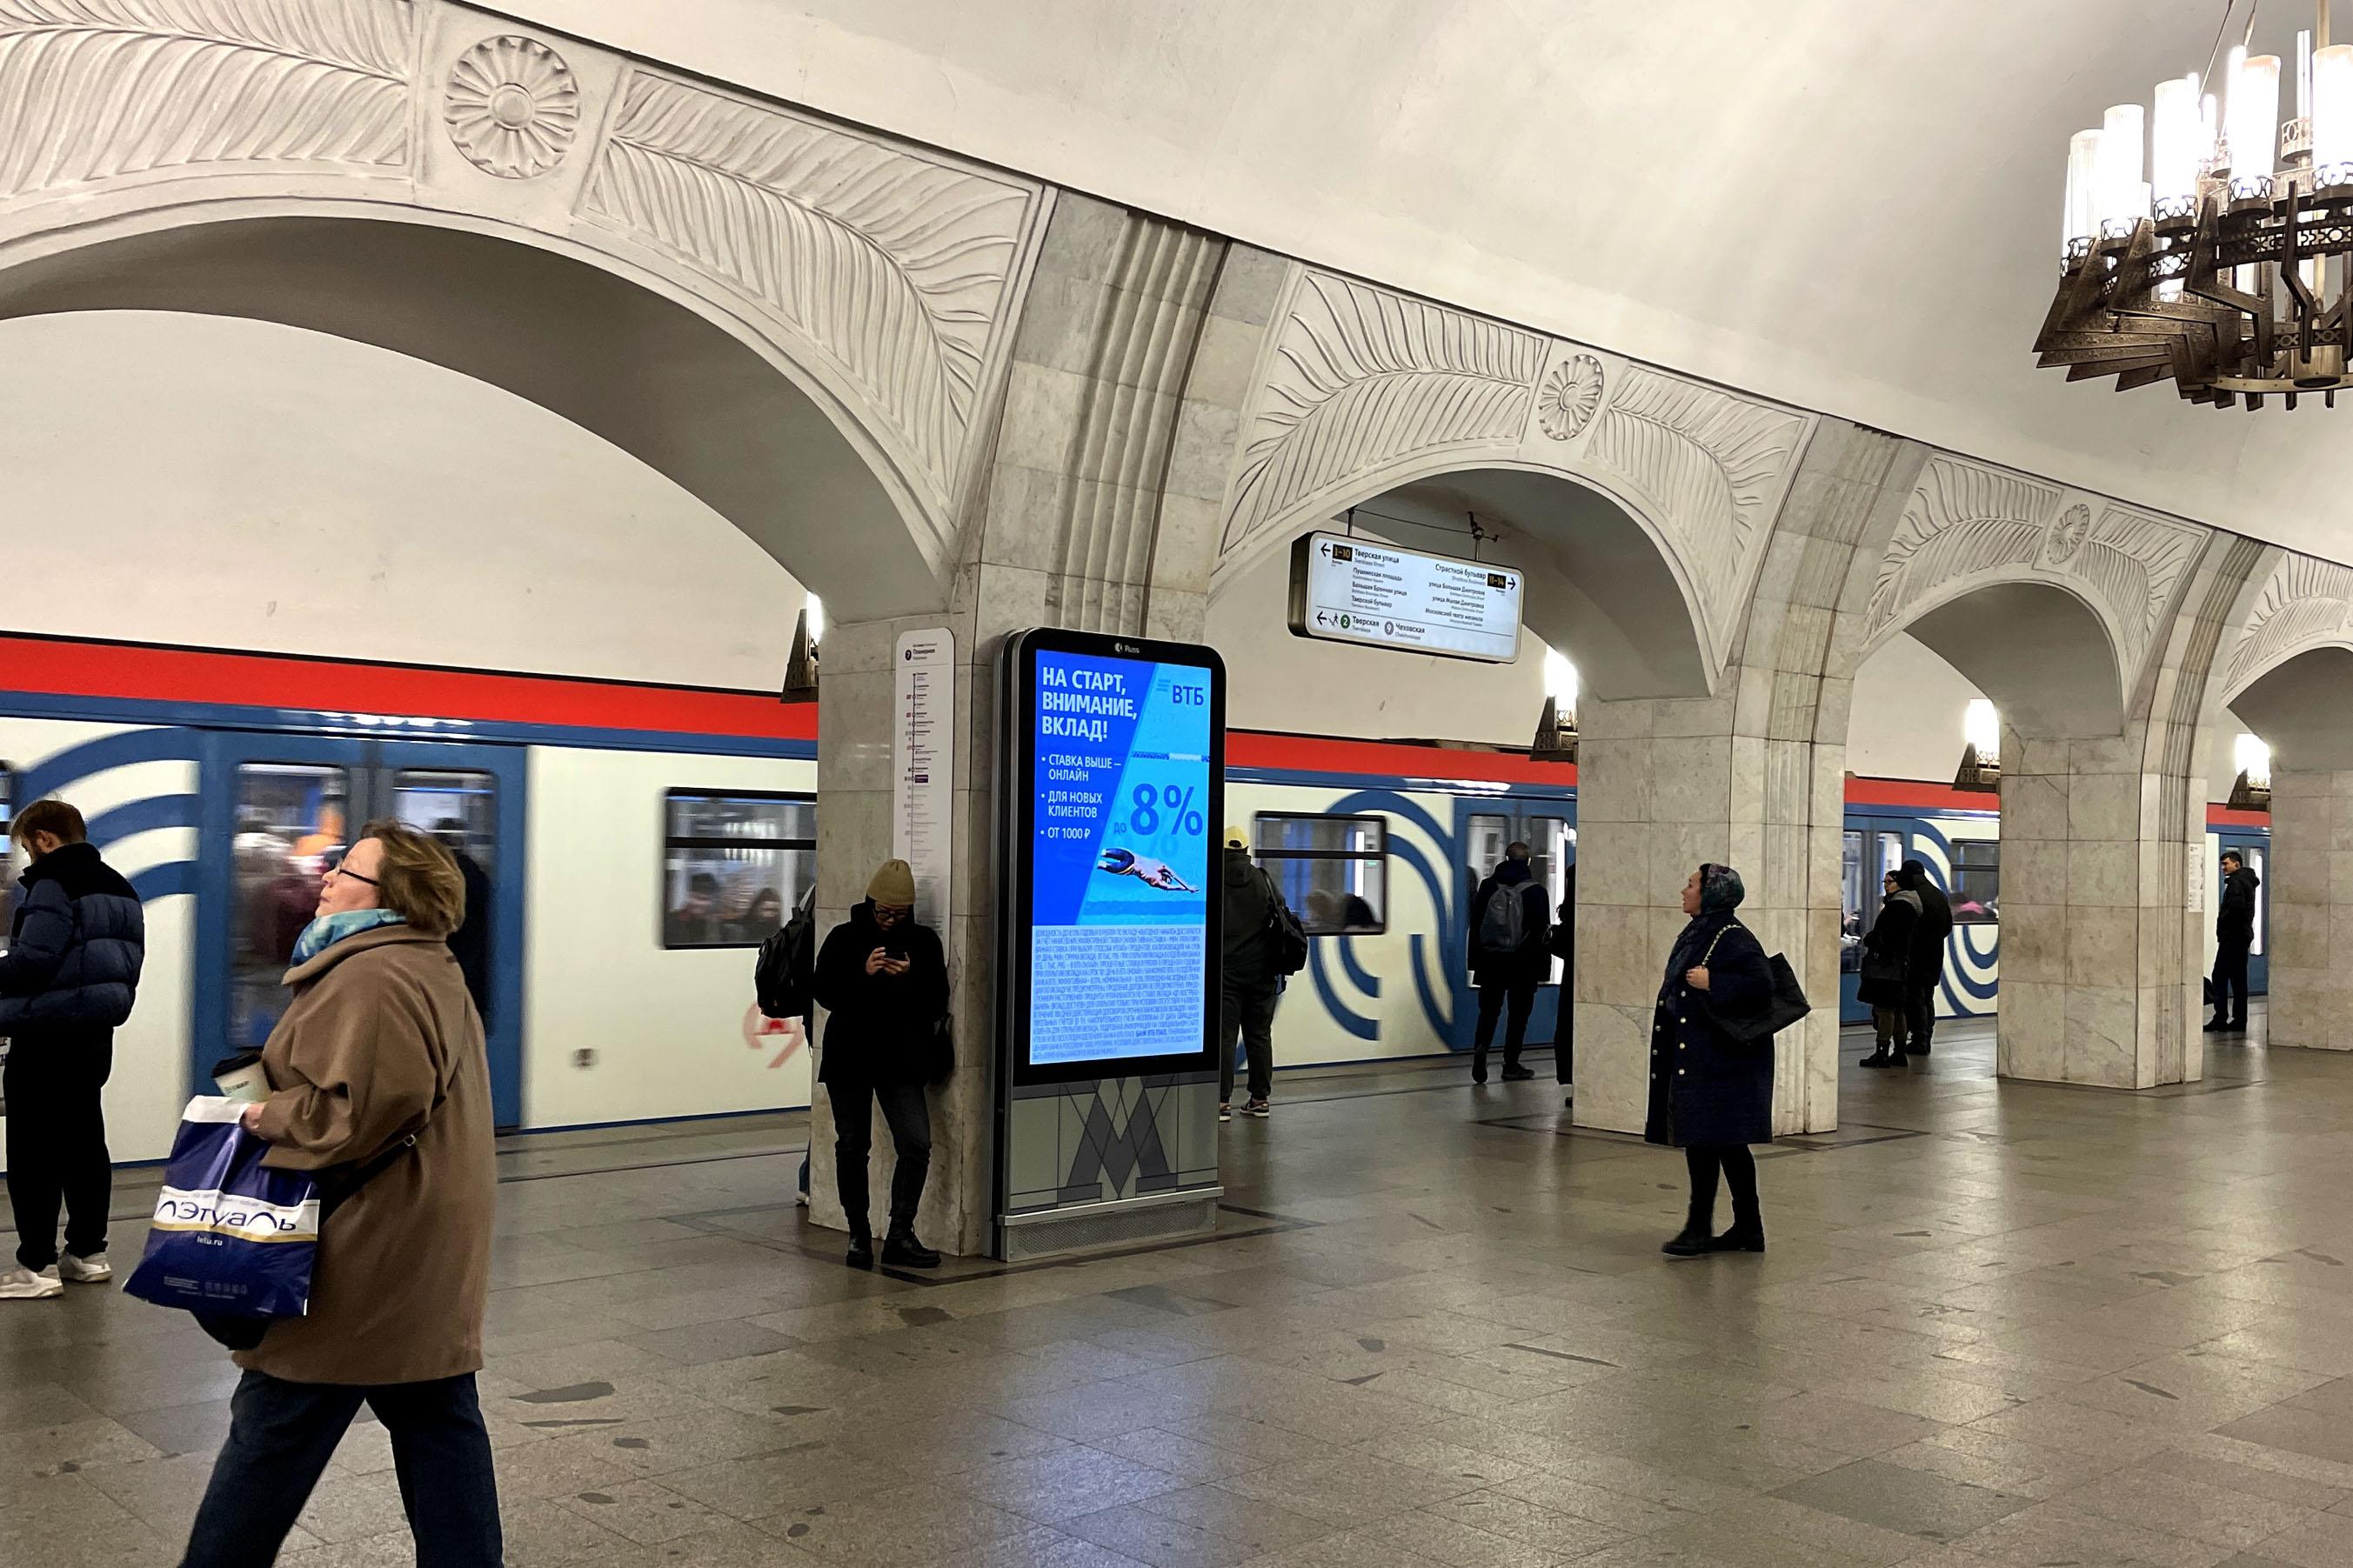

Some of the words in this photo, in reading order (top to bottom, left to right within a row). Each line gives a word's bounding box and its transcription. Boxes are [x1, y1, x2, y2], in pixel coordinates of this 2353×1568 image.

[1354, 548, 1381, 560] Тверская
[1381, 555, 1400, 564] улица
[1353, 567, 1382, 577] Пушкинская
[1435, 564, 1464, 575] Страстной
[1464, 569, 1487, 580] бульвар
[1352, 616, 1380, 627] Тверская
[1395, 623, 1426, 634] Чеховская
[1043, 666, 1067, 688] НА
[1072, 670, 1126, 696] СТАРТ,
[1173, 684, 1205, 706] ВТБ
[1042, 691, 1138, 720] ВНИМАНИЕ,
[1042, 715, 1108, 743] ВКЛАД!
[1048, 753, 1083, 767] СТАВКА
[1085, 756, 1113, 769] ВЫШЕ
[1048, 767, 1089, 782] ОНЛАЙН
[1047, 790, 1067, 804] ДЛЯ
[1069, 791, 1103, 804] НОВЫХ
[1048, 804, 1098, 818] КЛИЕНТОВ
[1047, 826, 1060, 839] ОТ
[1061, 827, 1083, 840] 1000
